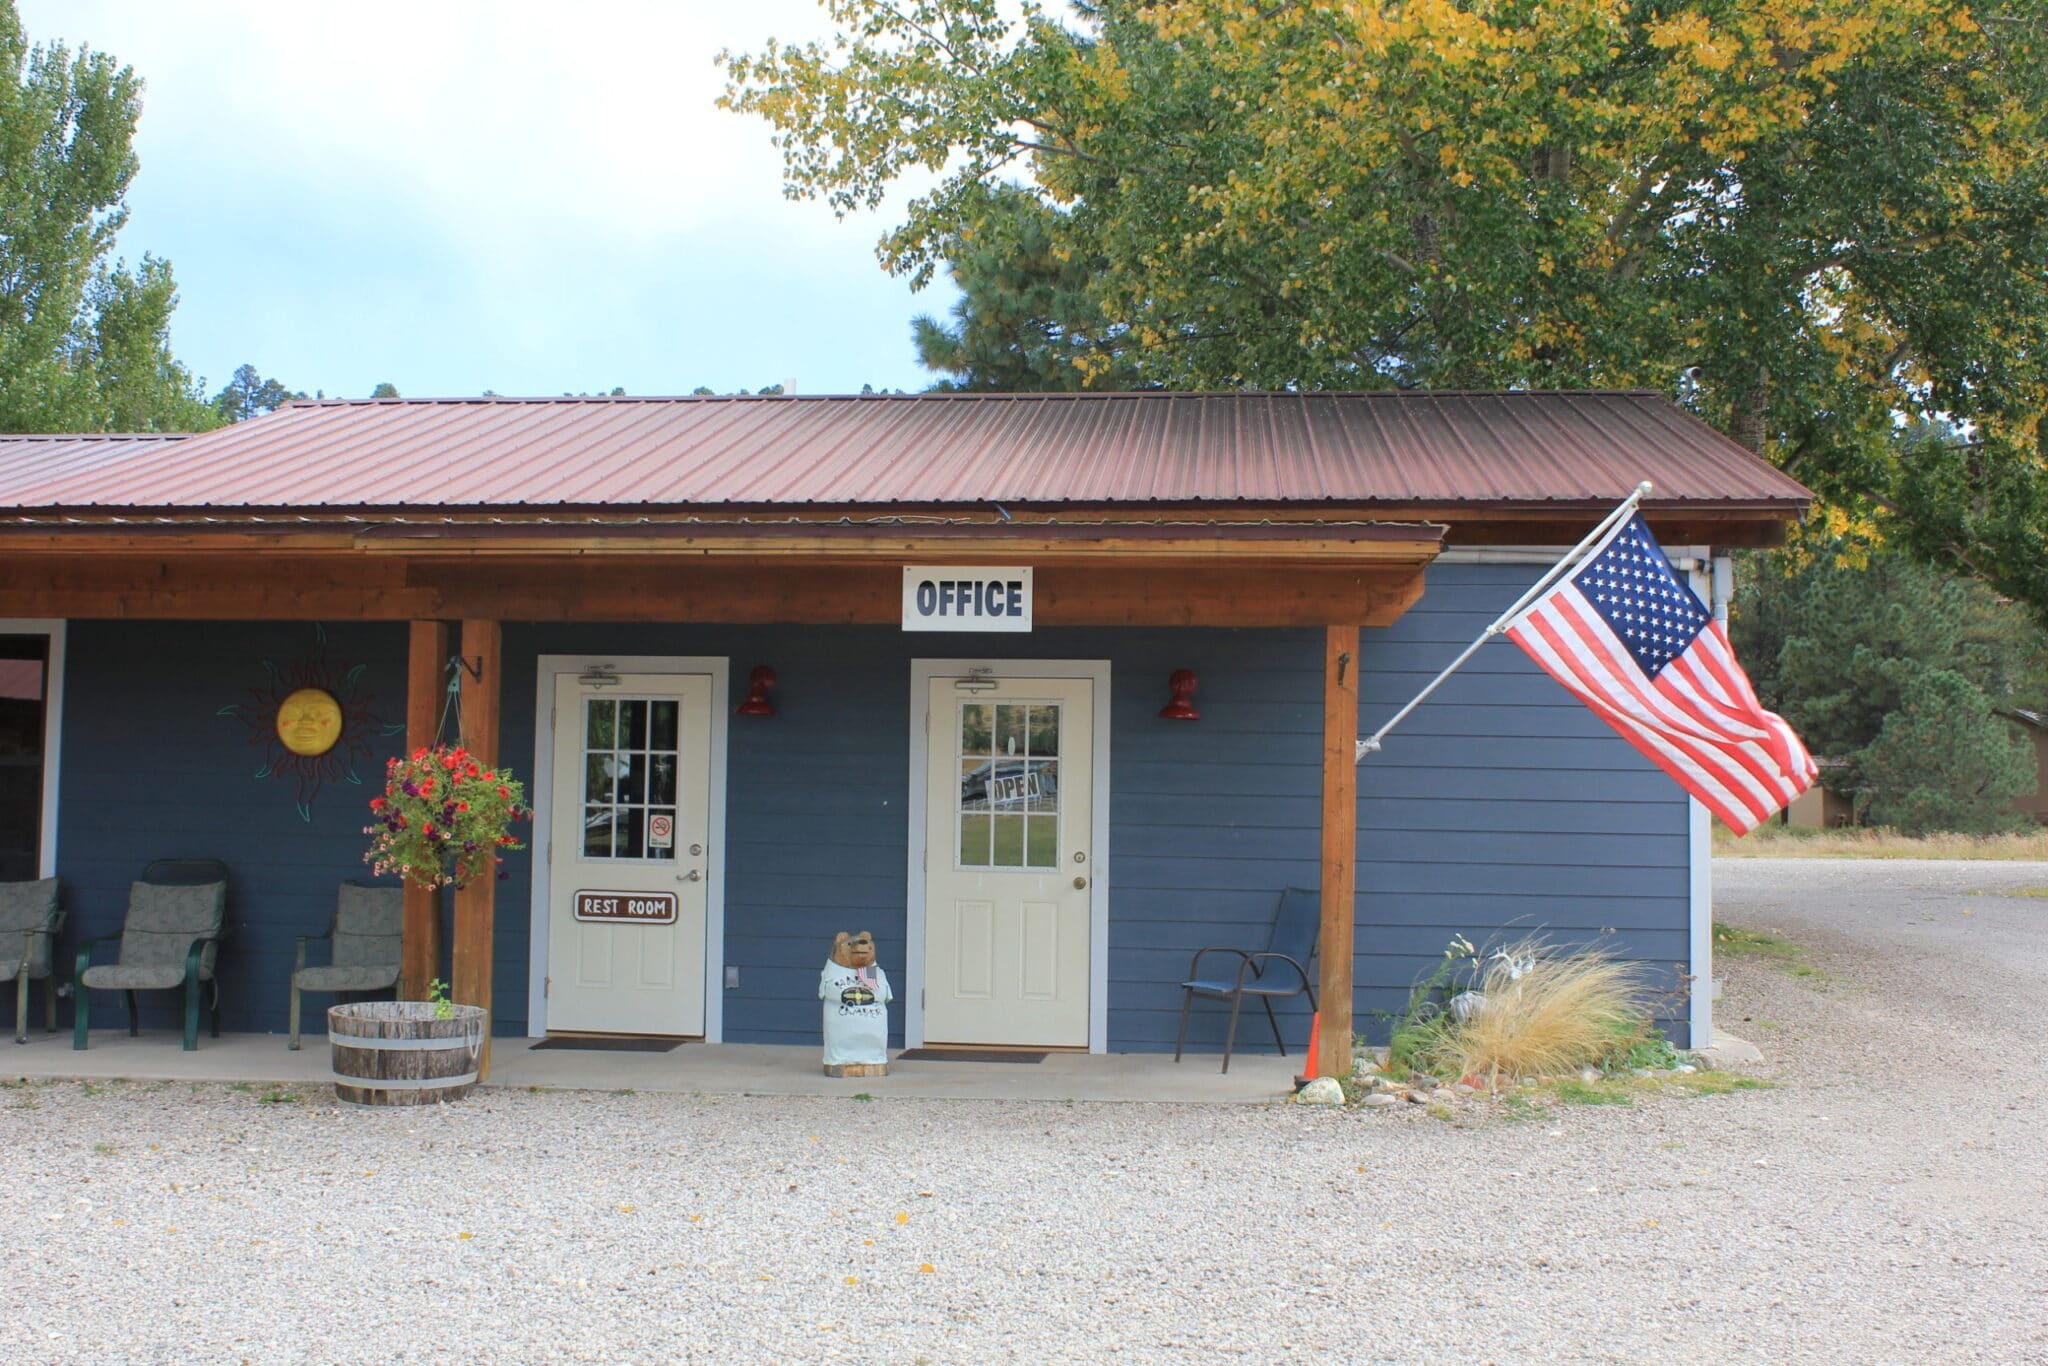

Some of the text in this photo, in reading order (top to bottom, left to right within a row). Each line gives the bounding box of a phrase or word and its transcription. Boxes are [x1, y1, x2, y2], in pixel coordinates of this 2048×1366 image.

[917, 580, 1022, 616] OFFICE
[993, 775, 1037, 801] OPEN
[584, 898, 666, 915] REST ROOM
